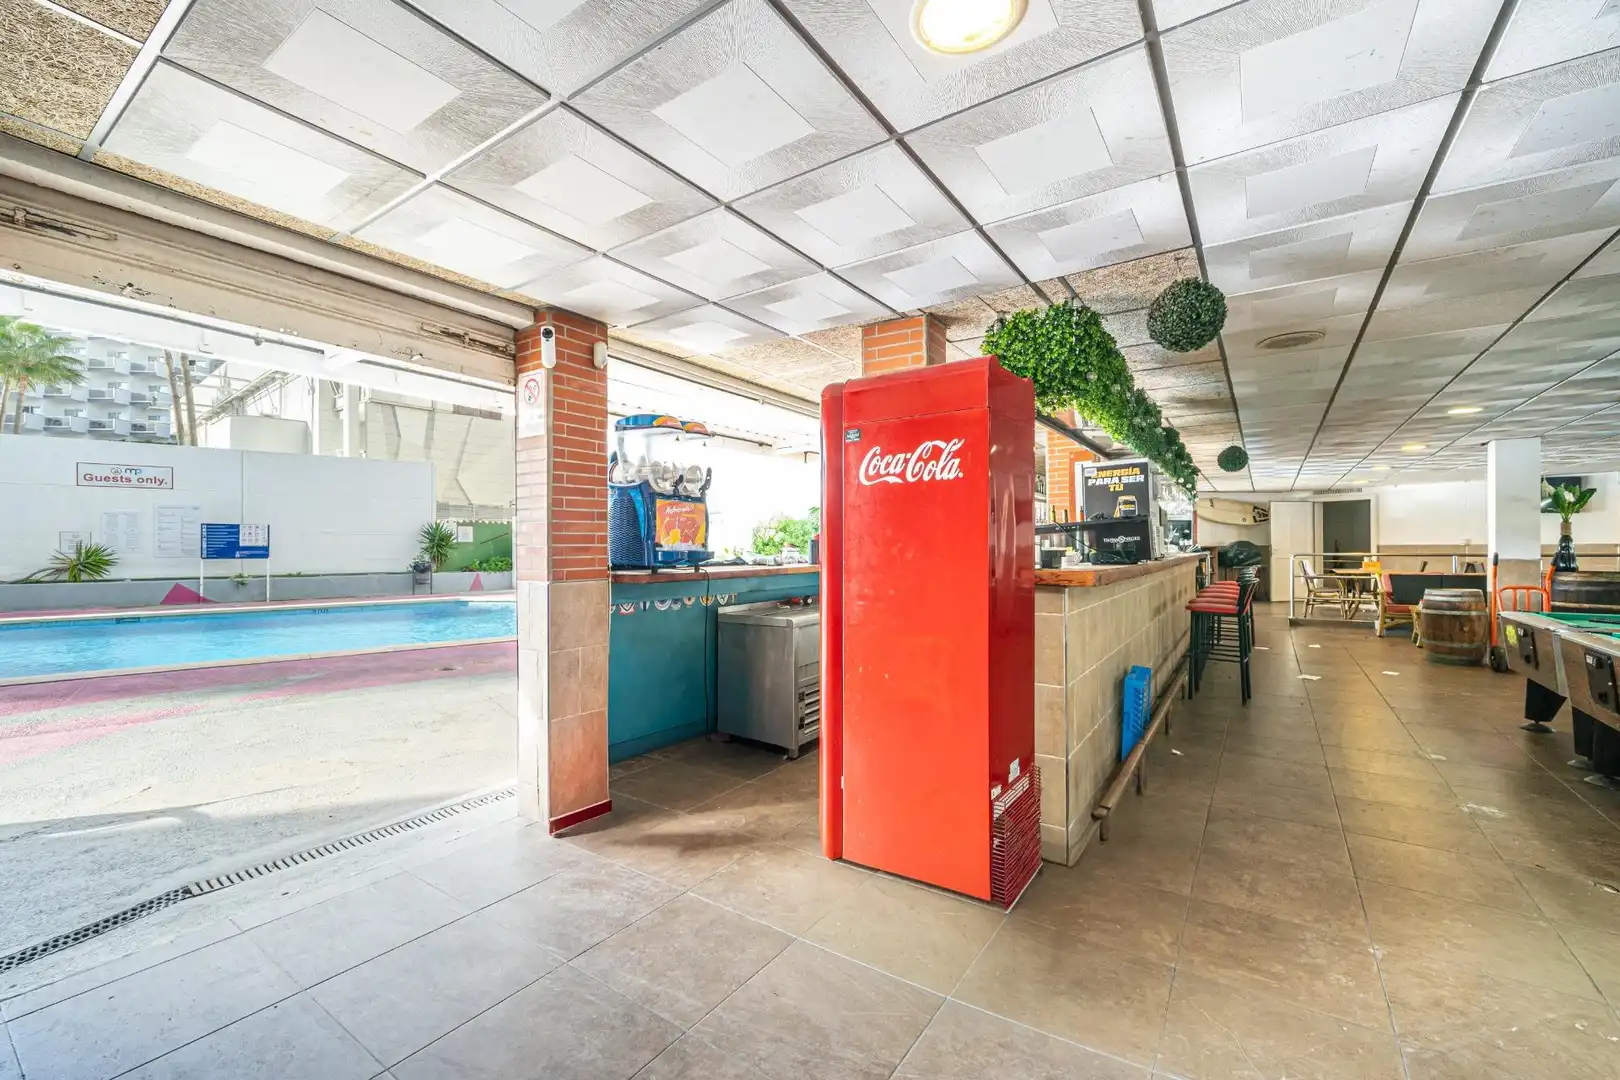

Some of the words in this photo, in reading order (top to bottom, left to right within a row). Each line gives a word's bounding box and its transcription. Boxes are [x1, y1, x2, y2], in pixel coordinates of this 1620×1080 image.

[83, 473, 132, 484] Guests
[136, 476, 168, 486] only.
[1088, 476, 1120, 486] PARA
[1120, 474, 1145, 484] SER
